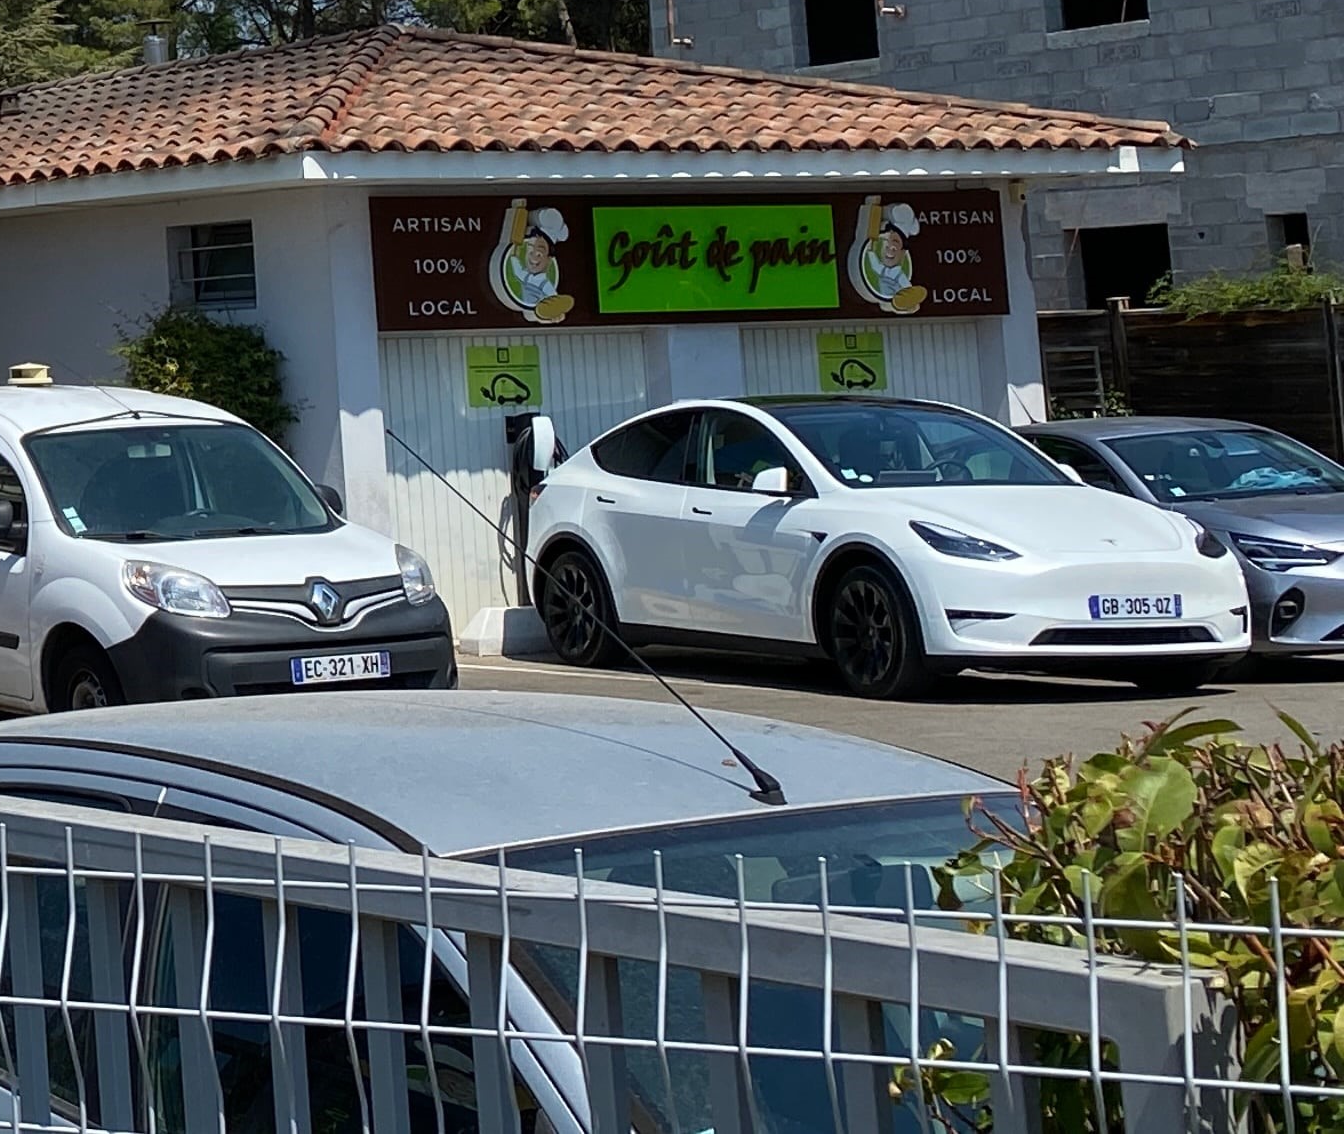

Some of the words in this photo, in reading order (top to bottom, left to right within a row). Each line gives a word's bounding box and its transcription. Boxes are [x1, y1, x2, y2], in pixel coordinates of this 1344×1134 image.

[393, 217, 482, 234] ARTISAN
[918, 210, 995, 225] ARTISAN
[608, 224, 698, 291] Goût
[707, 226, 744, 282] de
[749, 226, 836, 294] pain
[935, 249, 982, 264] 100%
[414, 258, 466, 274] 100%
[932, 288, 993, 303] LOCAL
[409, 300, 478, 316] LOCAL
